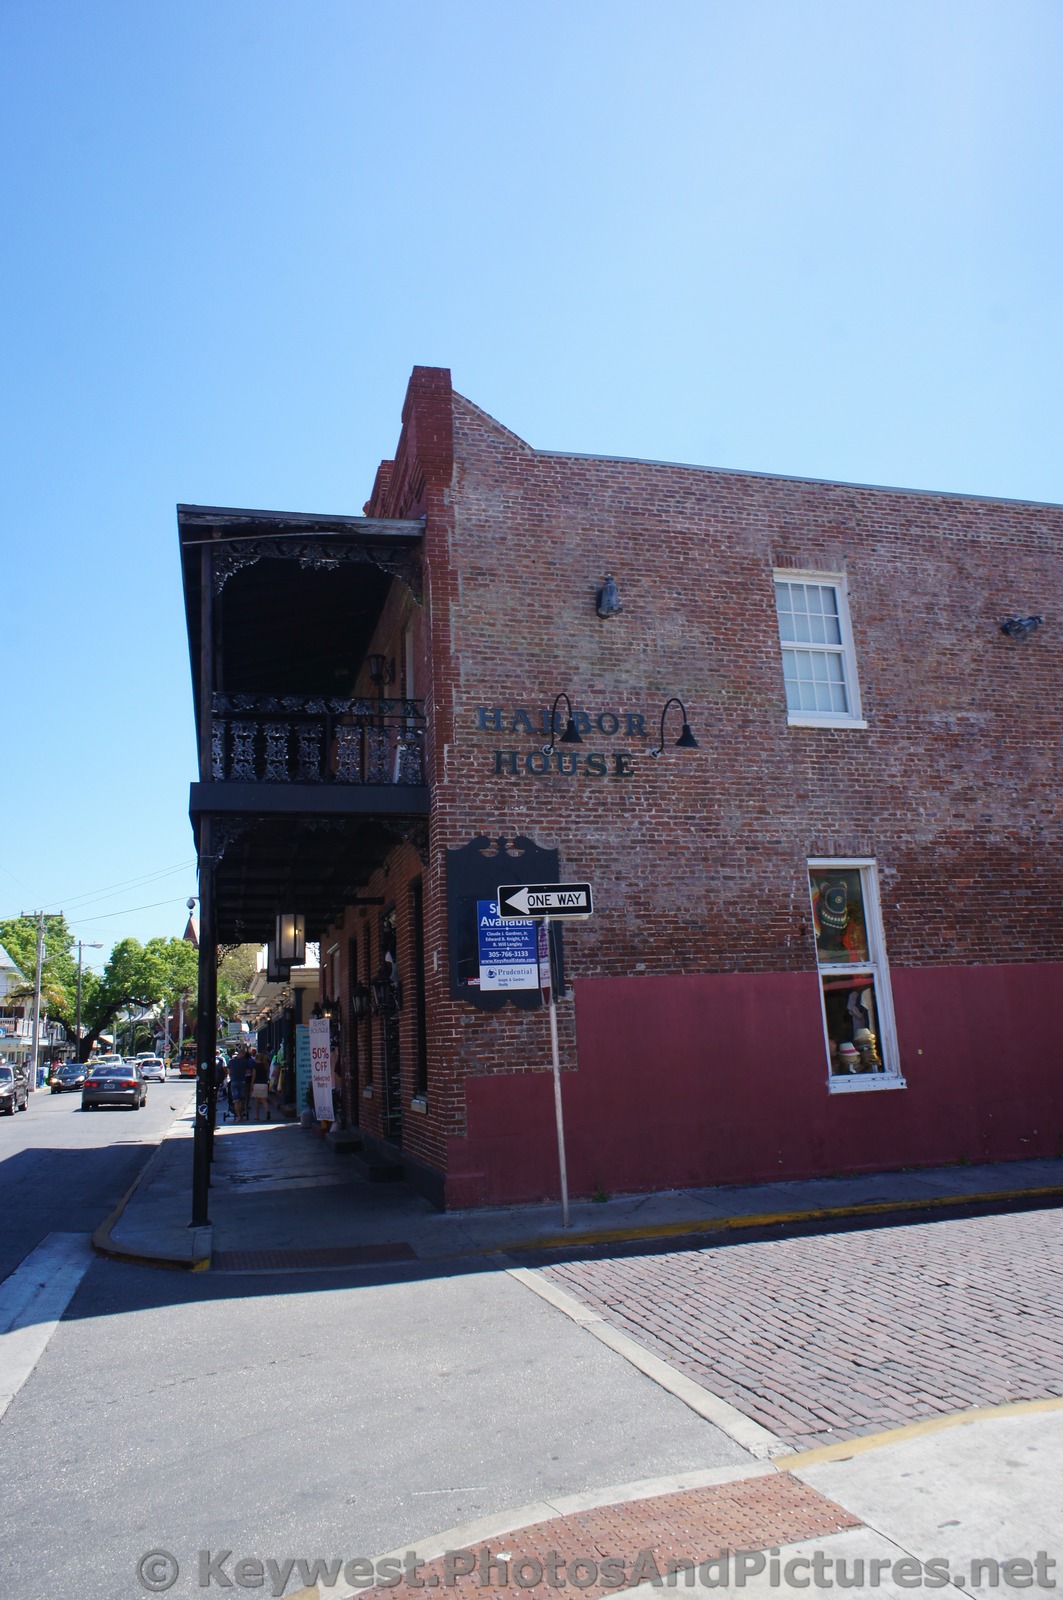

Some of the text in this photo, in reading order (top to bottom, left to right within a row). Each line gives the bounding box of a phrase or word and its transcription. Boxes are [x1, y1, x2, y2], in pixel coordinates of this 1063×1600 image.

[475, 707, 649, 737] HARBOR
[492, 750, 635, 777] HOUSE
[527, 893, 581, 906] ONE WAY
[480, 916, 533, 926] Available
[498, 968, 532, 976] Prudential
[312, 1047, 330, 1060] 50%
[315, 1061, 328, 1072] OFF
